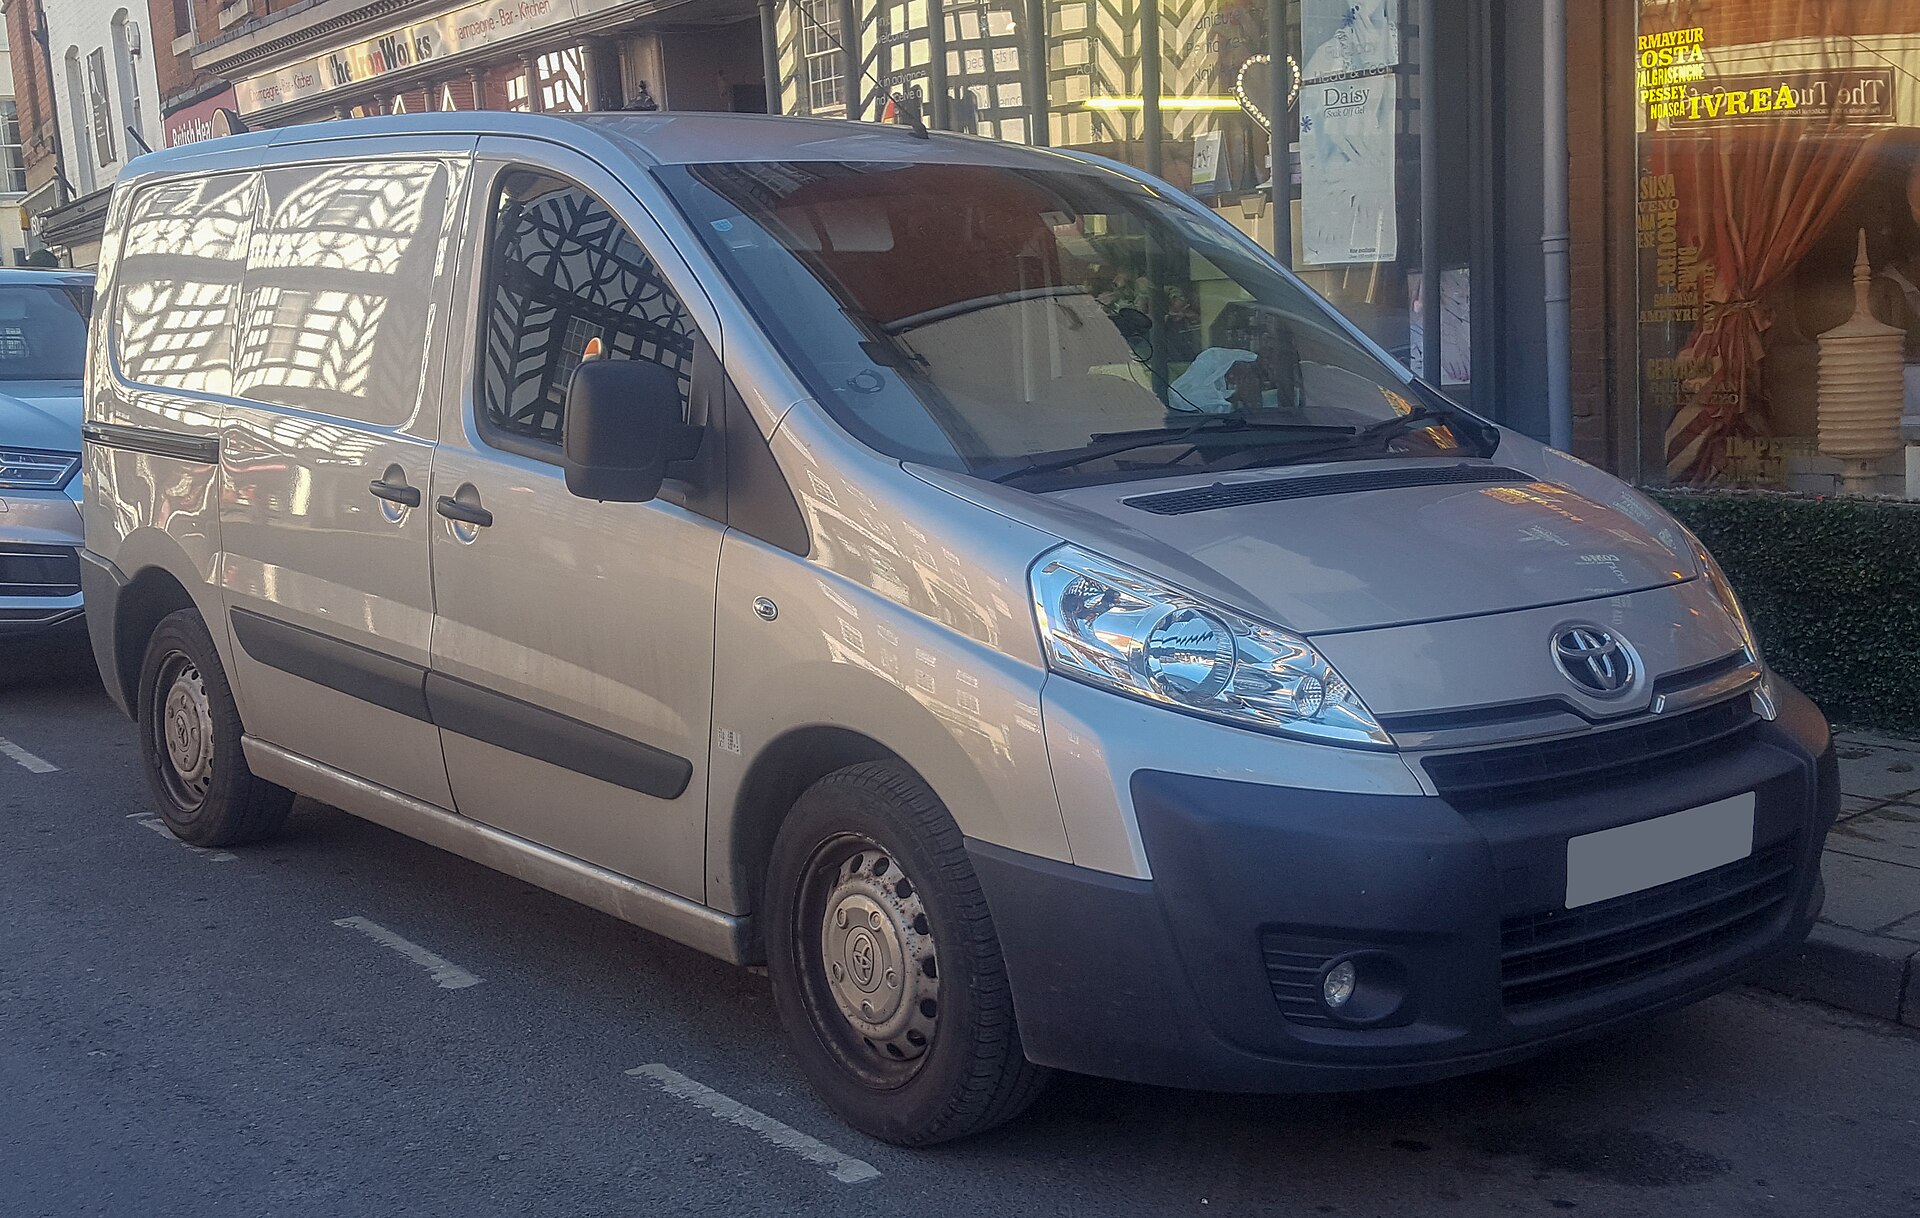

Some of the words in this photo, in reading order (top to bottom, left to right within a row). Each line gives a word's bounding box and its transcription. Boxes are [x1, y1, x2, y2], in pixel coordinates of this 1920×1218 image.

[498, 8, 514, 26] Bar
[518, 0, 551, 20] Kitchen
[1324, 85, 1370, 107] Daisy
[1640, 85, 1687, 104] PESSEY
[1688, 84, 1797, 120] IVREA
[1650, 101, 1686, 120] NOASCA
[172, 119, 196, 148] British
[1640, 173, 1676, 199] SUSA
